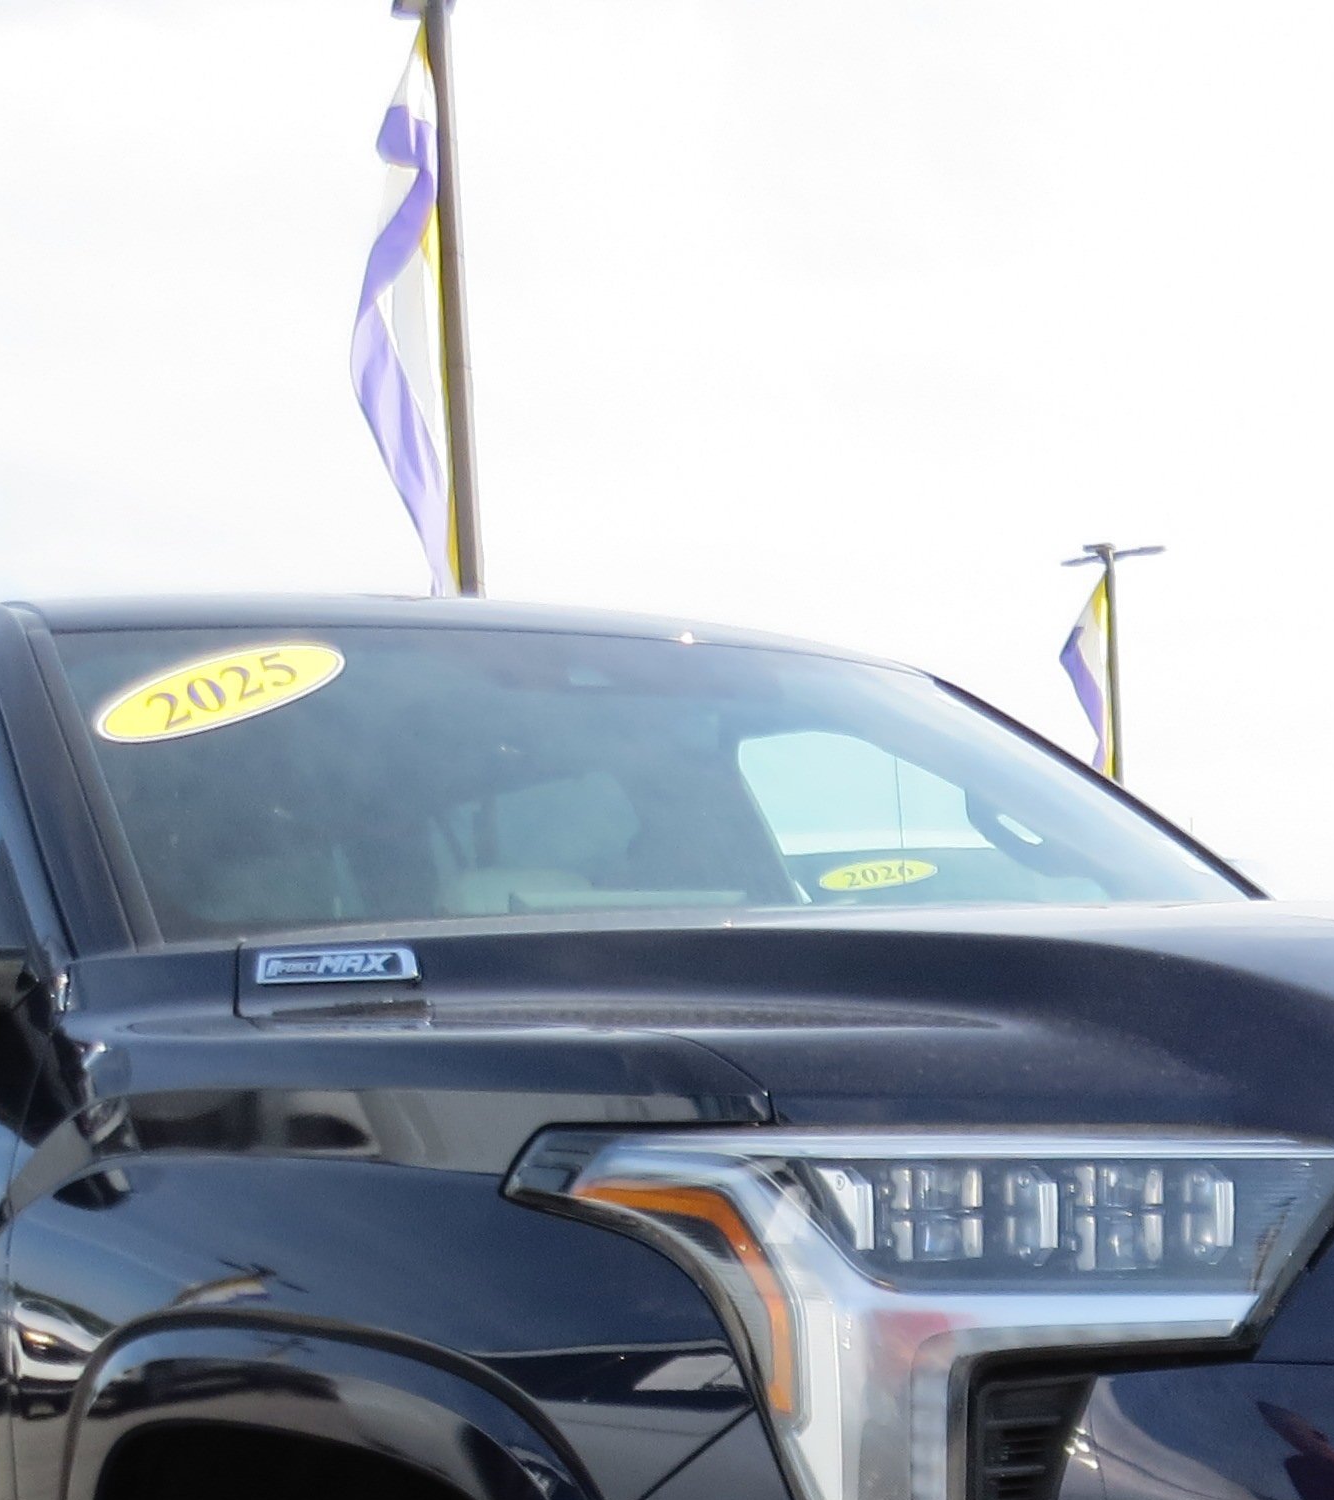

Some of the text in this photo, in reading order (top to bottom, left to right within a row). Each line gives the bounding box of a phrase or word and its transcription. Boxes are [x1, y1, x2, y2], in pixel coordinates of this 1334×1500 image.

[145, 653, 298, 731] 2025
[843, 865, 914, 889] 2026
[317, 953, 394, 975] MAX
